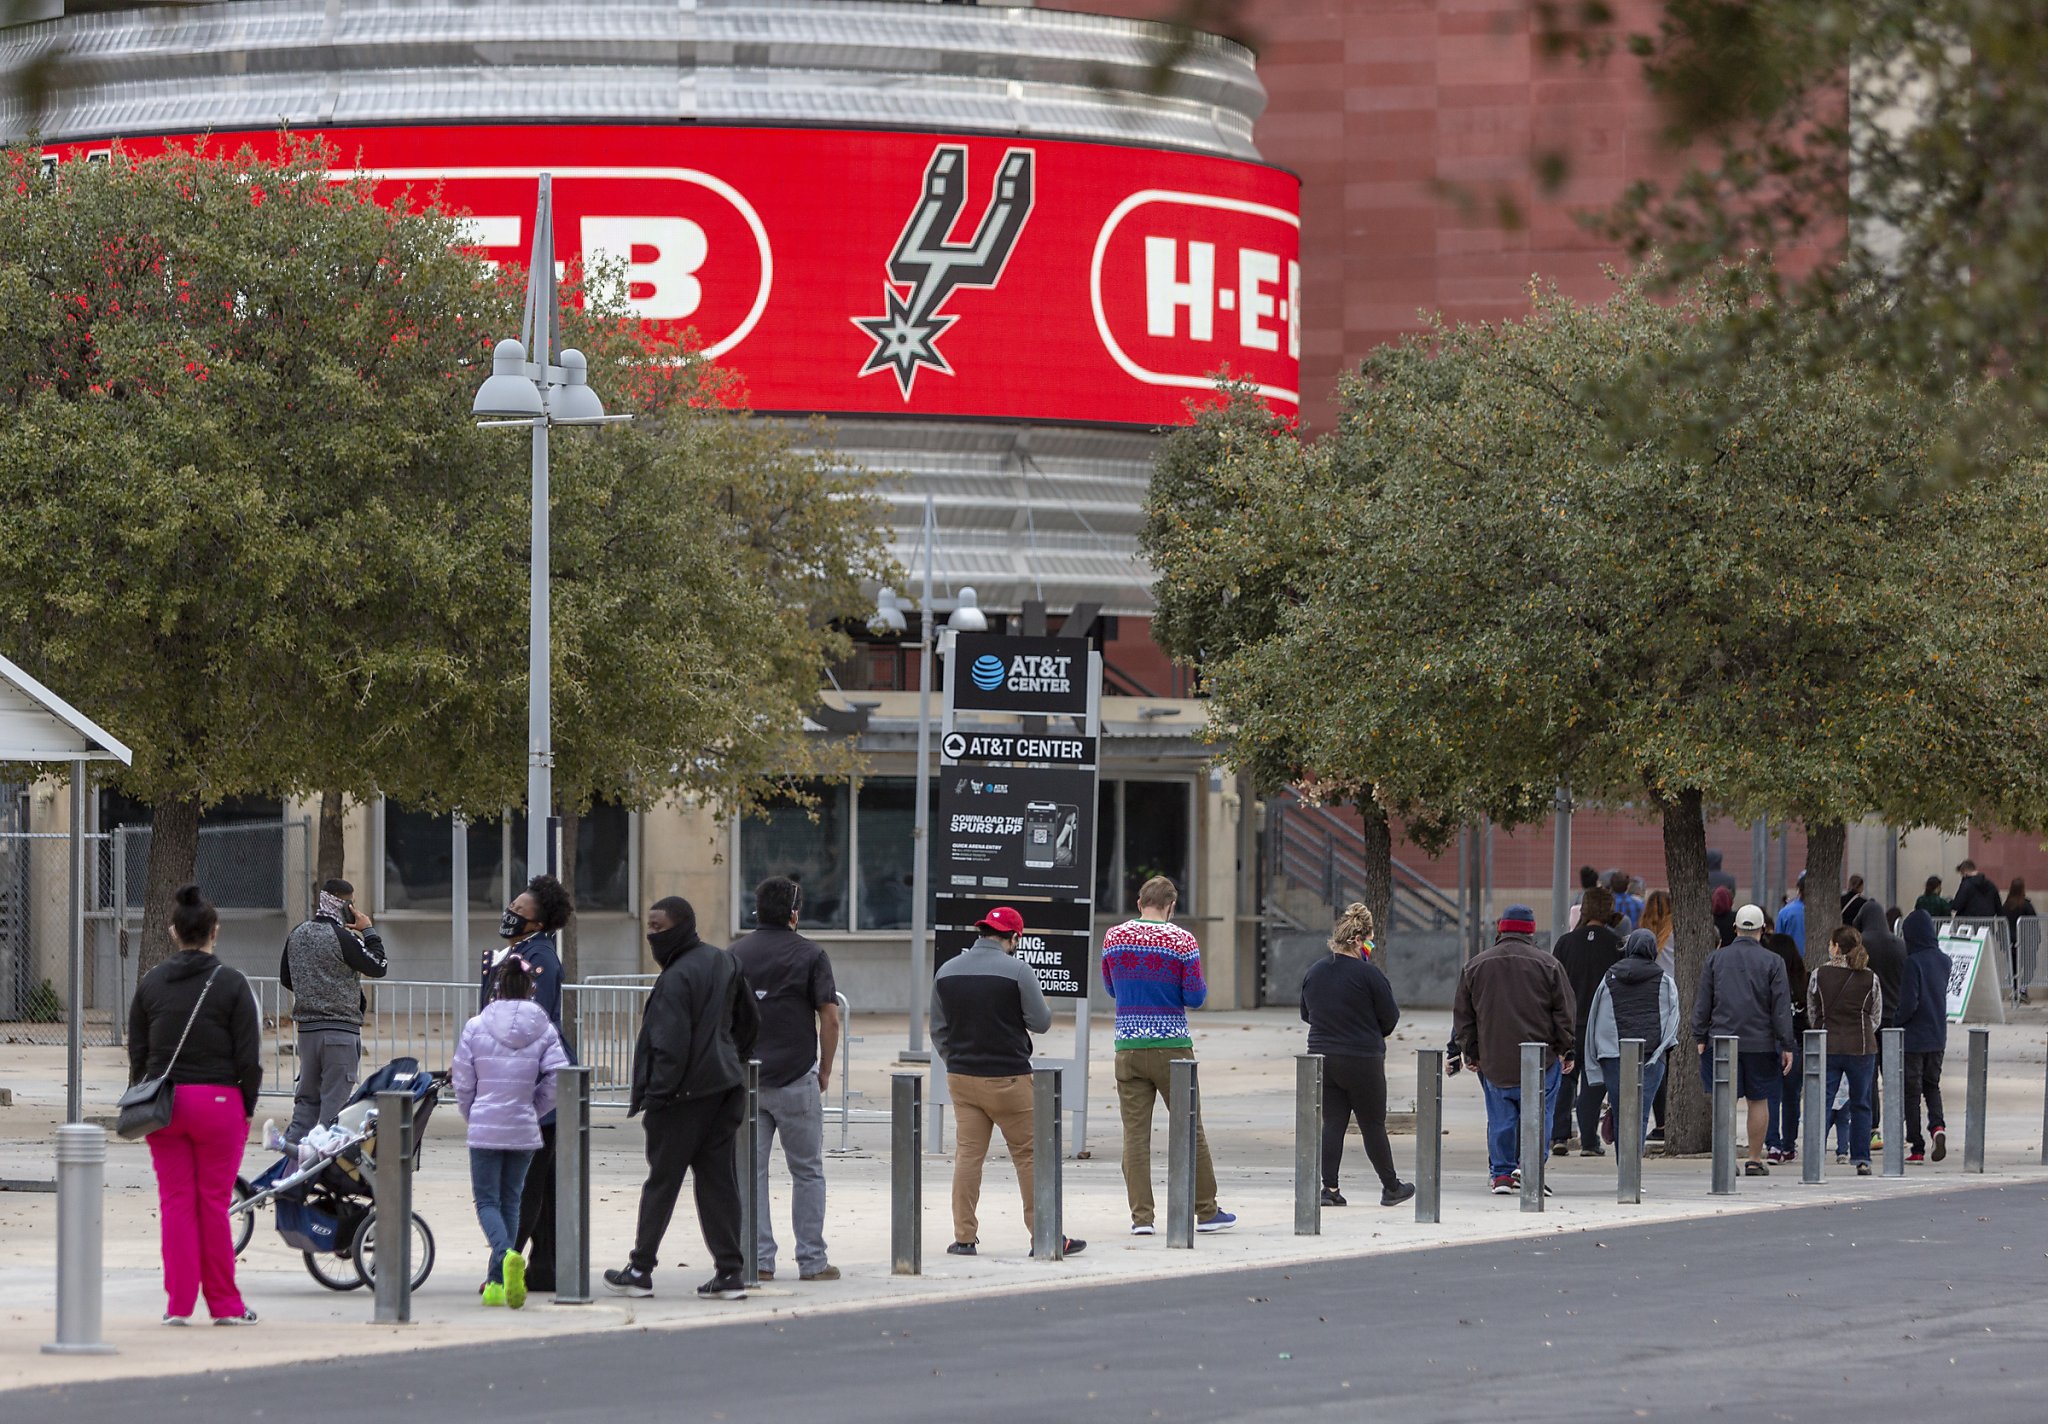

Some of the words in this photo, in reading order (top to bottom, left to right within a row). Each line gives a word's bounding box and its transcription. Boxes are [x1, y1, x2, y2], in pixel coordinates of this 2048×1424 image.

[1008, 655, 1072, 678] AT&T
[1007, 677, 1071, 693] CENTER
[969, 737, 1014, 757] AT&T
[1016, 738, 1083, 759] CENTER
[951, 814, 1005, 824] DOWNLOAD
[1005, 816, 1025, 825] THE
[950, 822, 994, 834] SPURS
[994, 824, 1023, 835] APP
[1018, 936, 1045, 950] ING:
[1013, 950, 1063, 965] EWARE
[1039, 980, 1079, 992] OURCES
